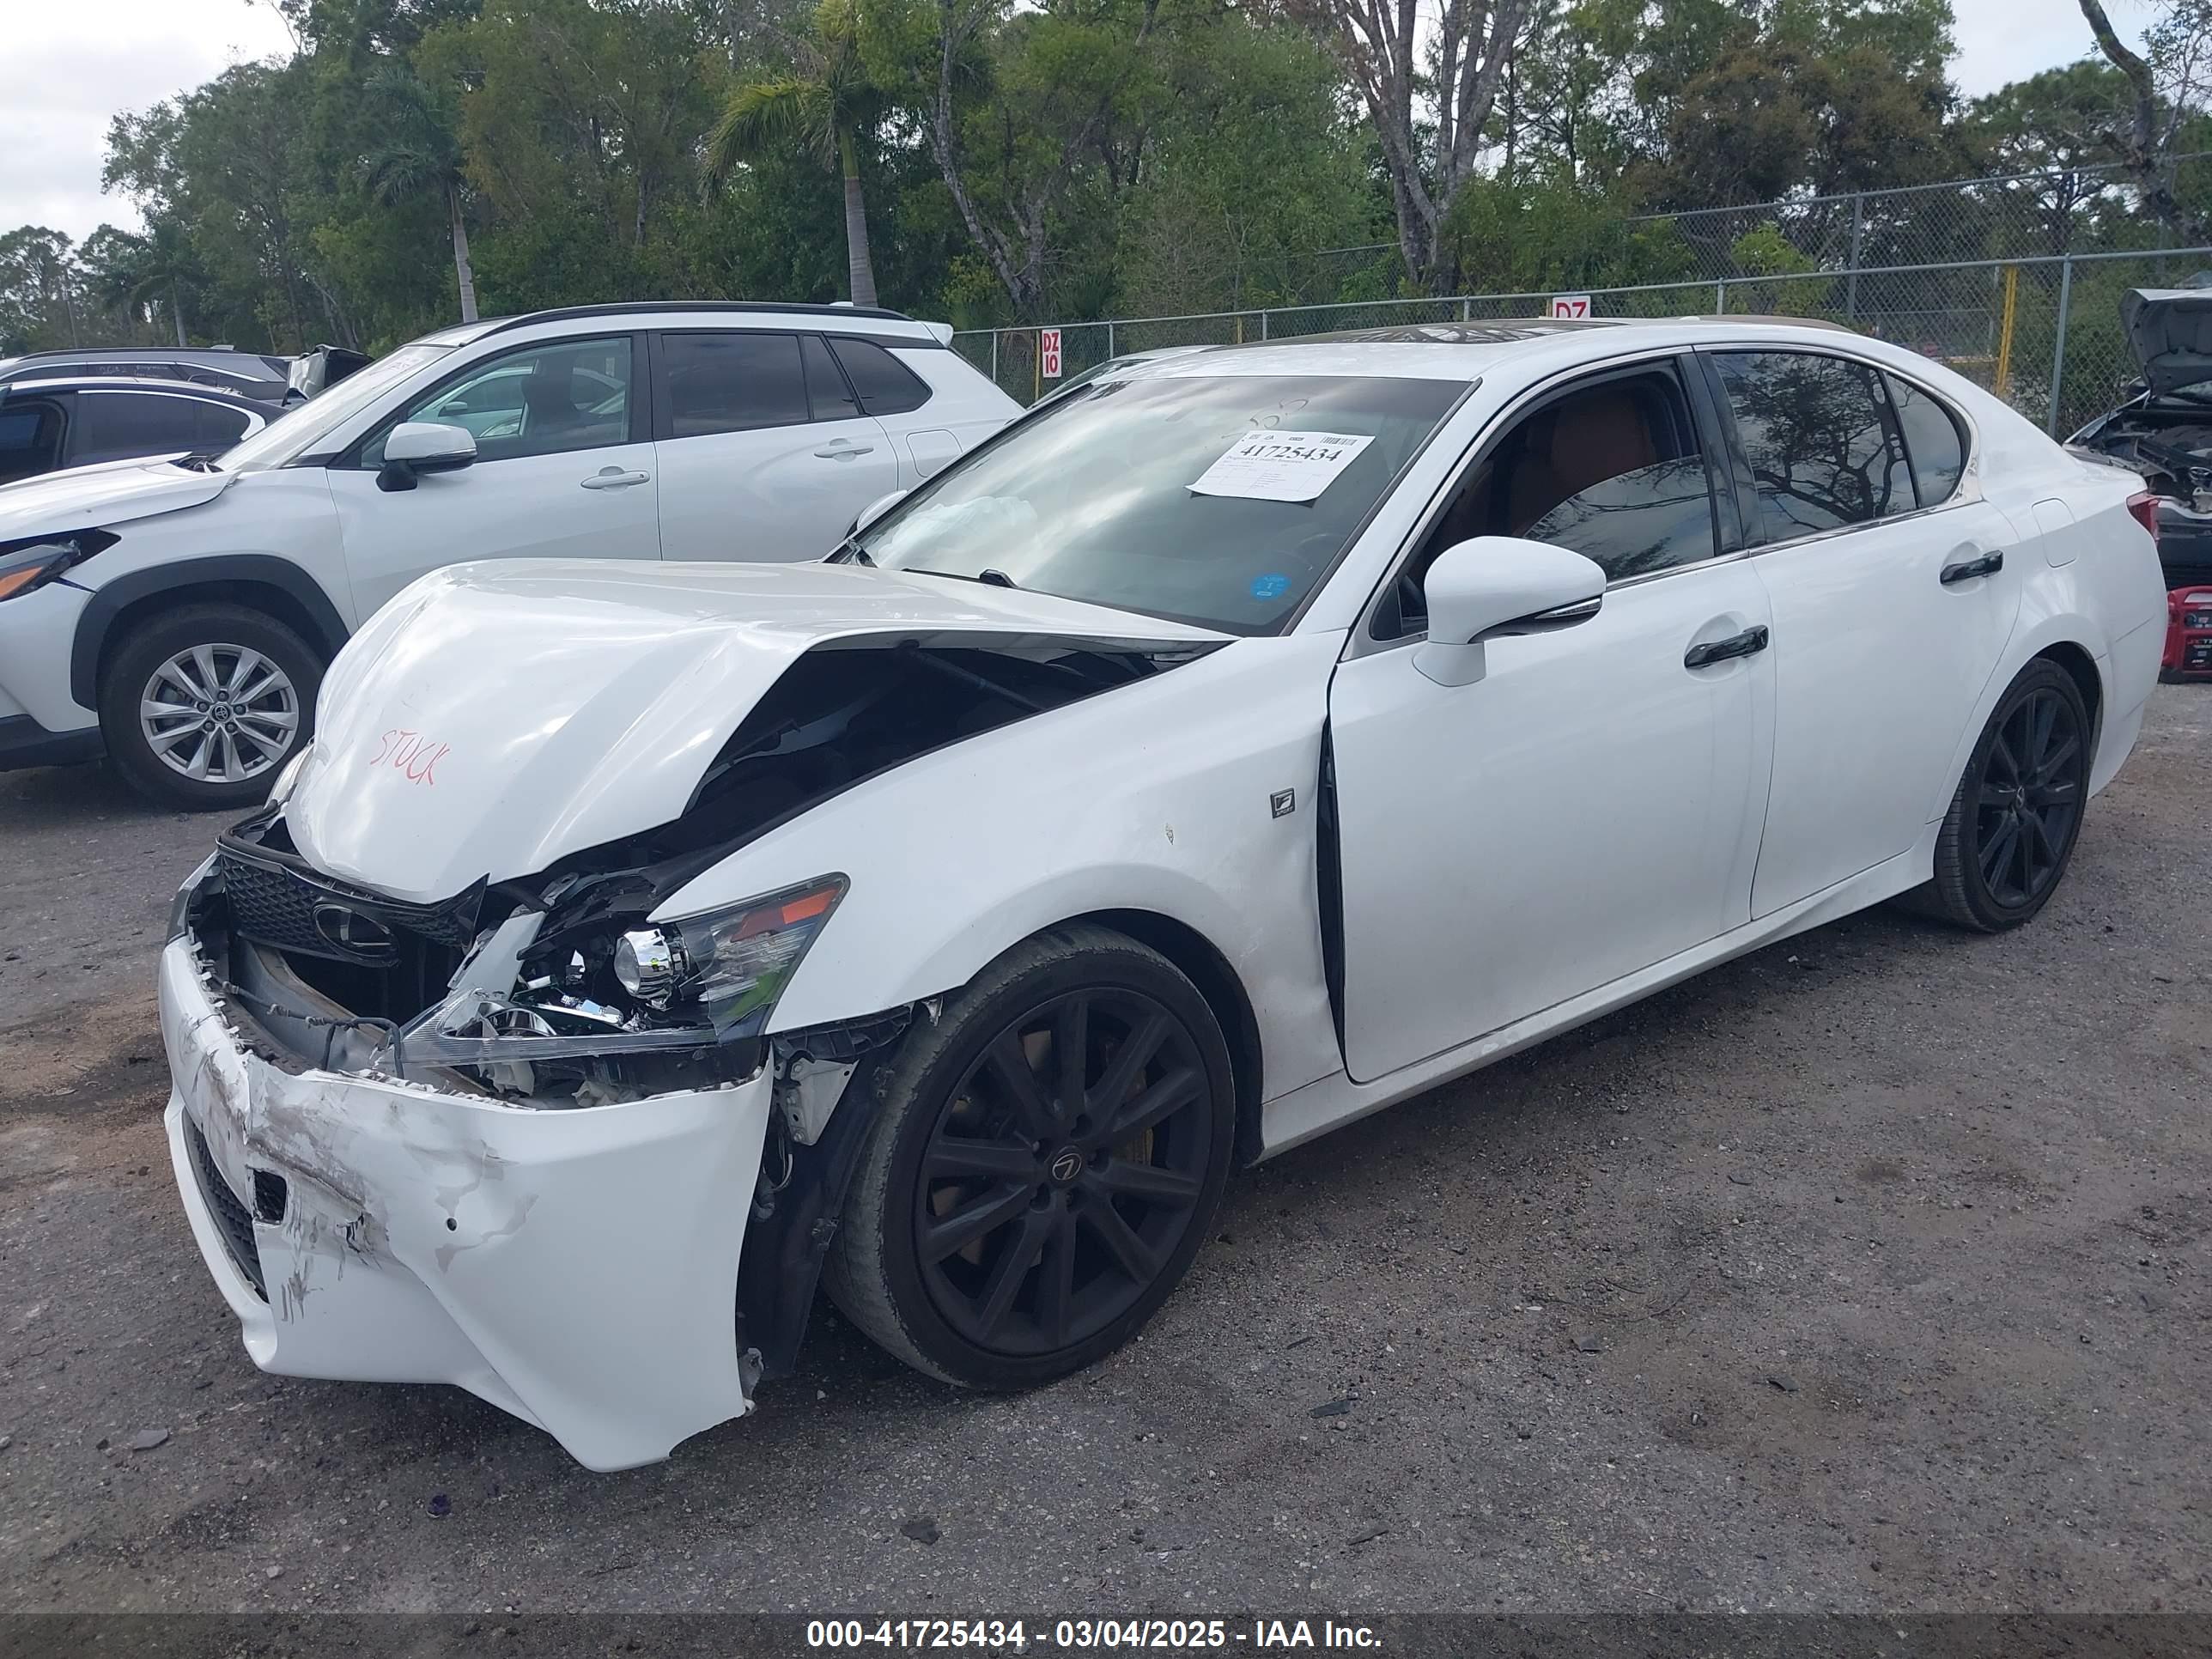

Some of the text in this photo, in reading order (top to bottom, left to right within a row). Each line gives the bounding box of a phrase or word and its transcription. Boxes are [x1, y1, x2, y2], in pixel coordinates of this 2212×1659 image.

[1556, 301, 1587, 319] DZ
[1043, 331, 1060, 352] DZ
[1045, 354, 1058, 374] 10
[1240, 444, 1343, 462] 41725434
[369, 729, 450, 785] STUCK
